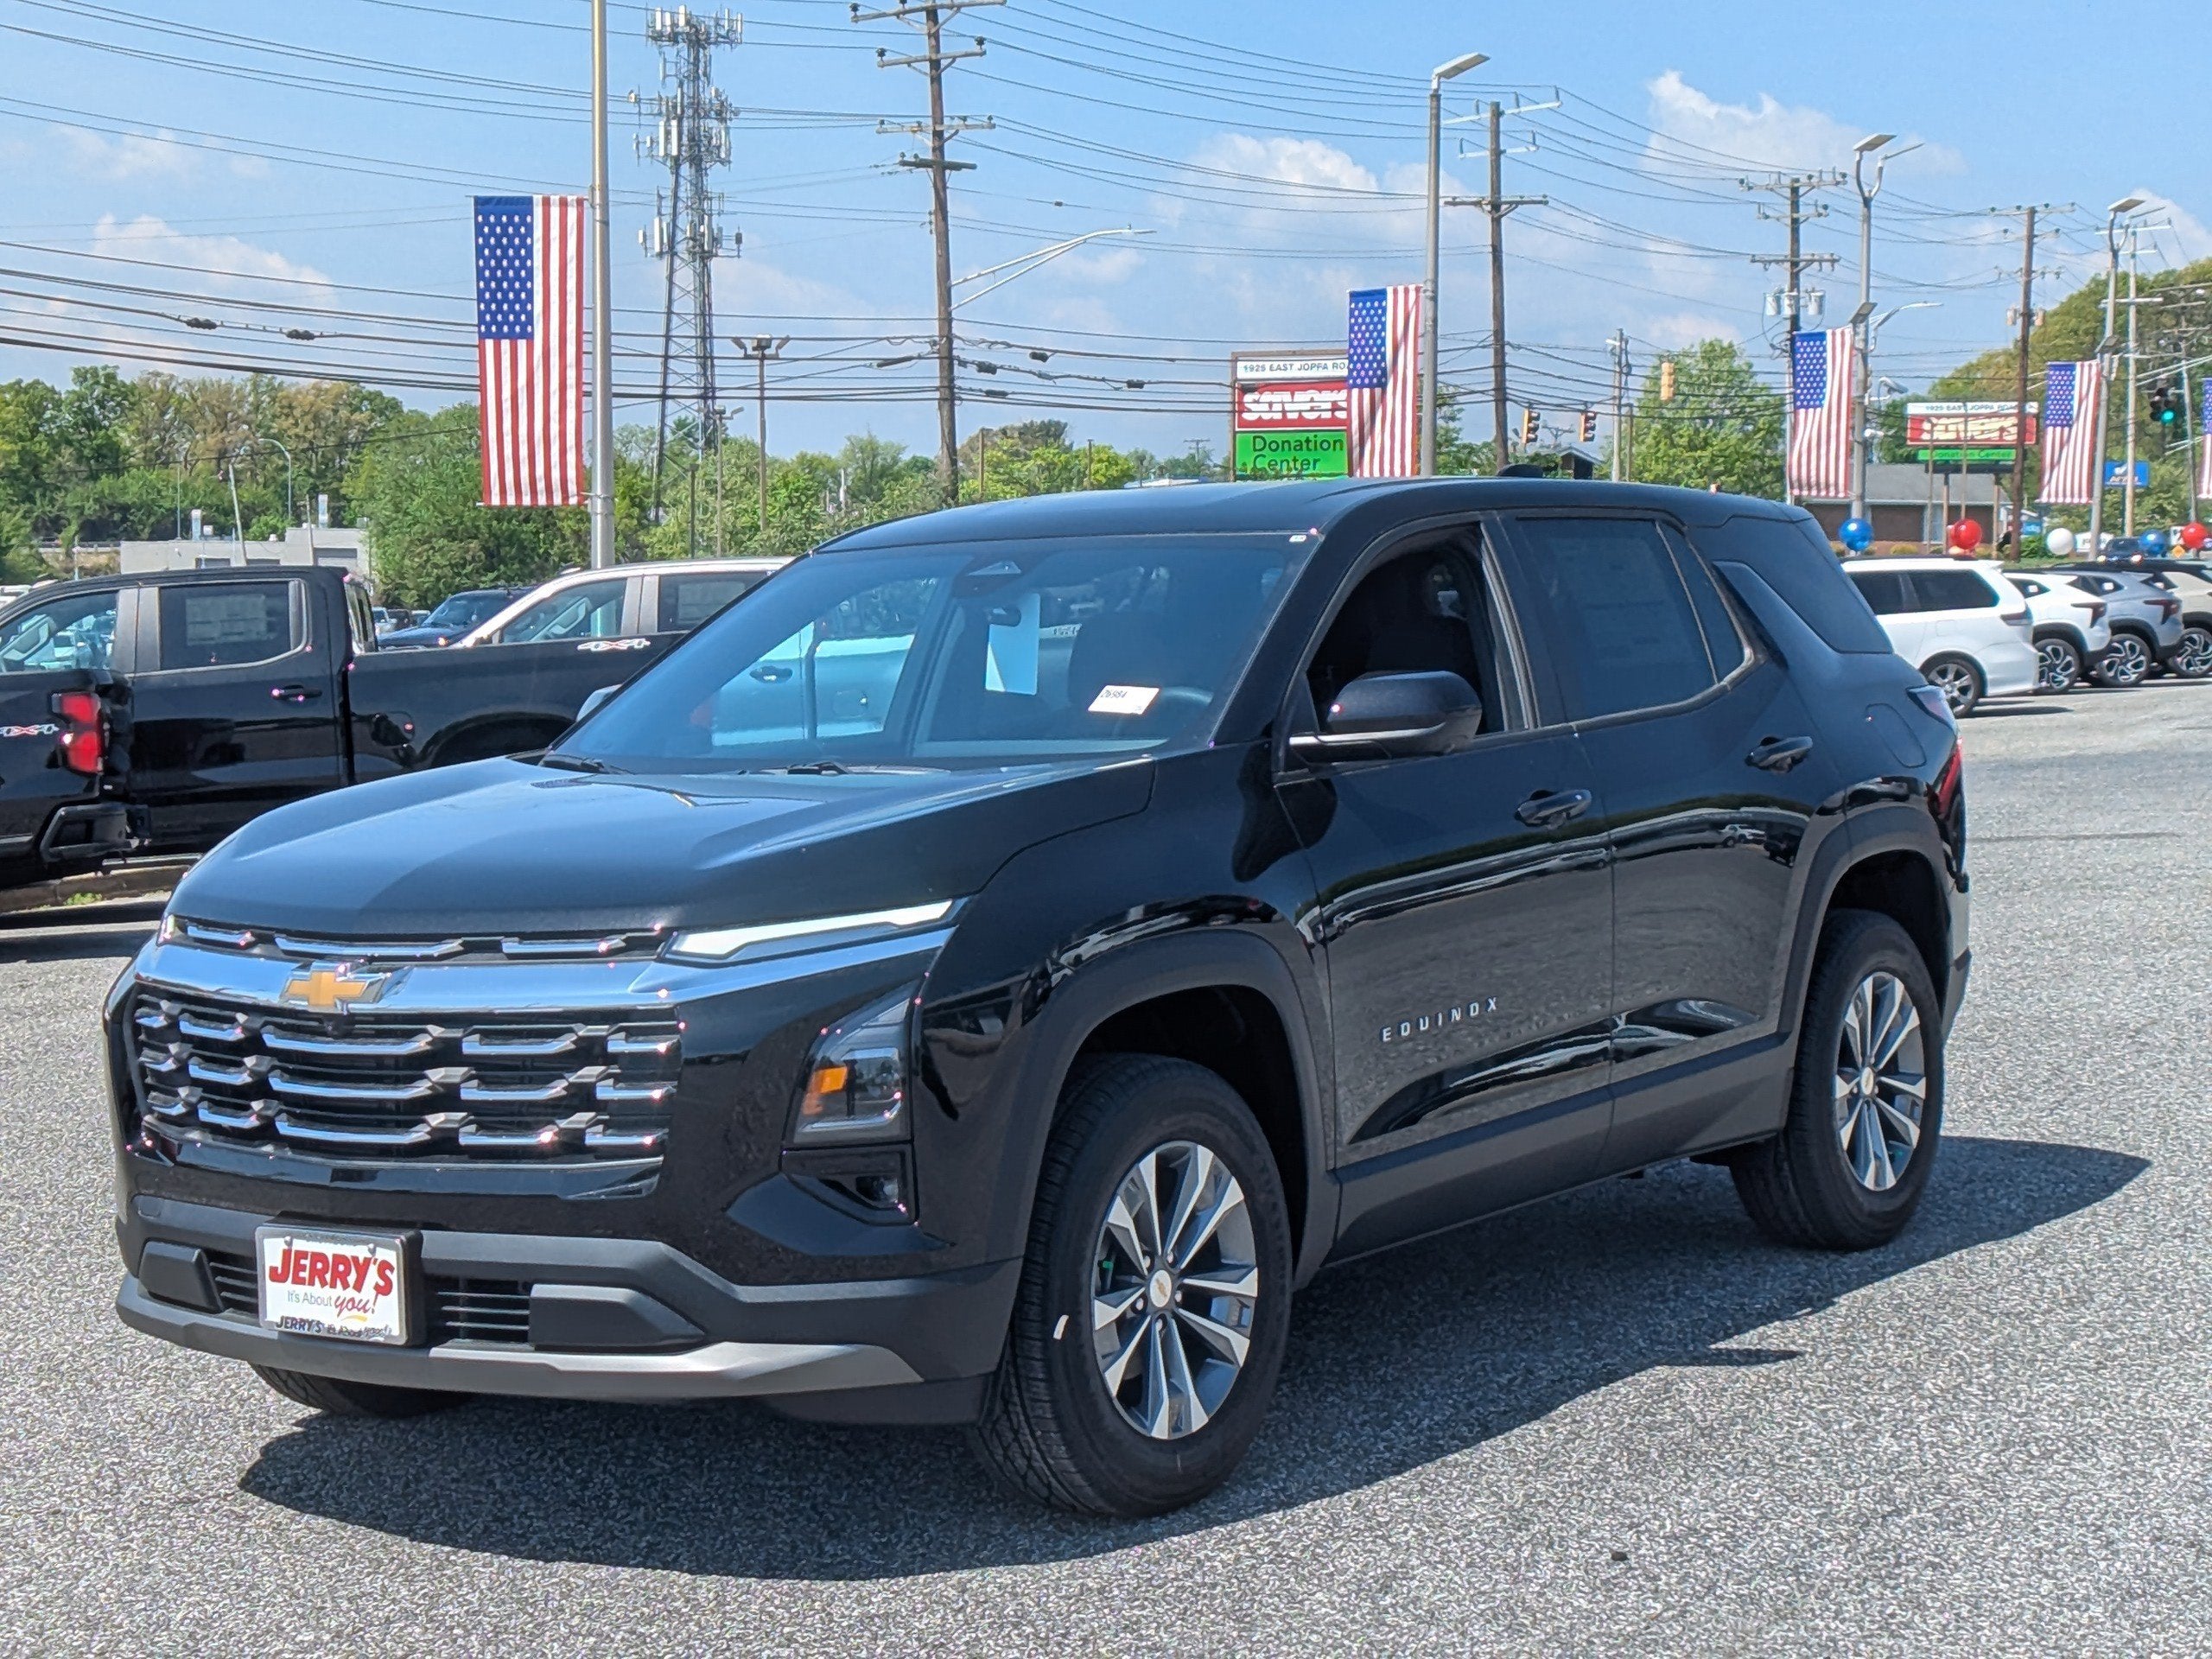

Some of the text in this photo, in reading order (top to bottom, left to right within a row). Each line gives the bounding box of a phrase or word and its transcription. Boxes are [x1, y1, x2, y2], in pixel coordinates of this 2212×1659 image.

[1269, 363, 1294, 372] EAST
[1297, 362, 1328, 372] JOPPA
[1332, 361, 1349, 371] RO
[1252, 434, 1344, 452] Donation
[1252, 454, 1322, 472] Center
[1381, 996, 1497, 1042] EQUINOX
[269, 1249, 396, 1296] JERRY'S
[302, 1292, 334, 1307] About
[334, 1292, 379, 1319] you!
[276, 1315, 324, 1334] JERRY'S
